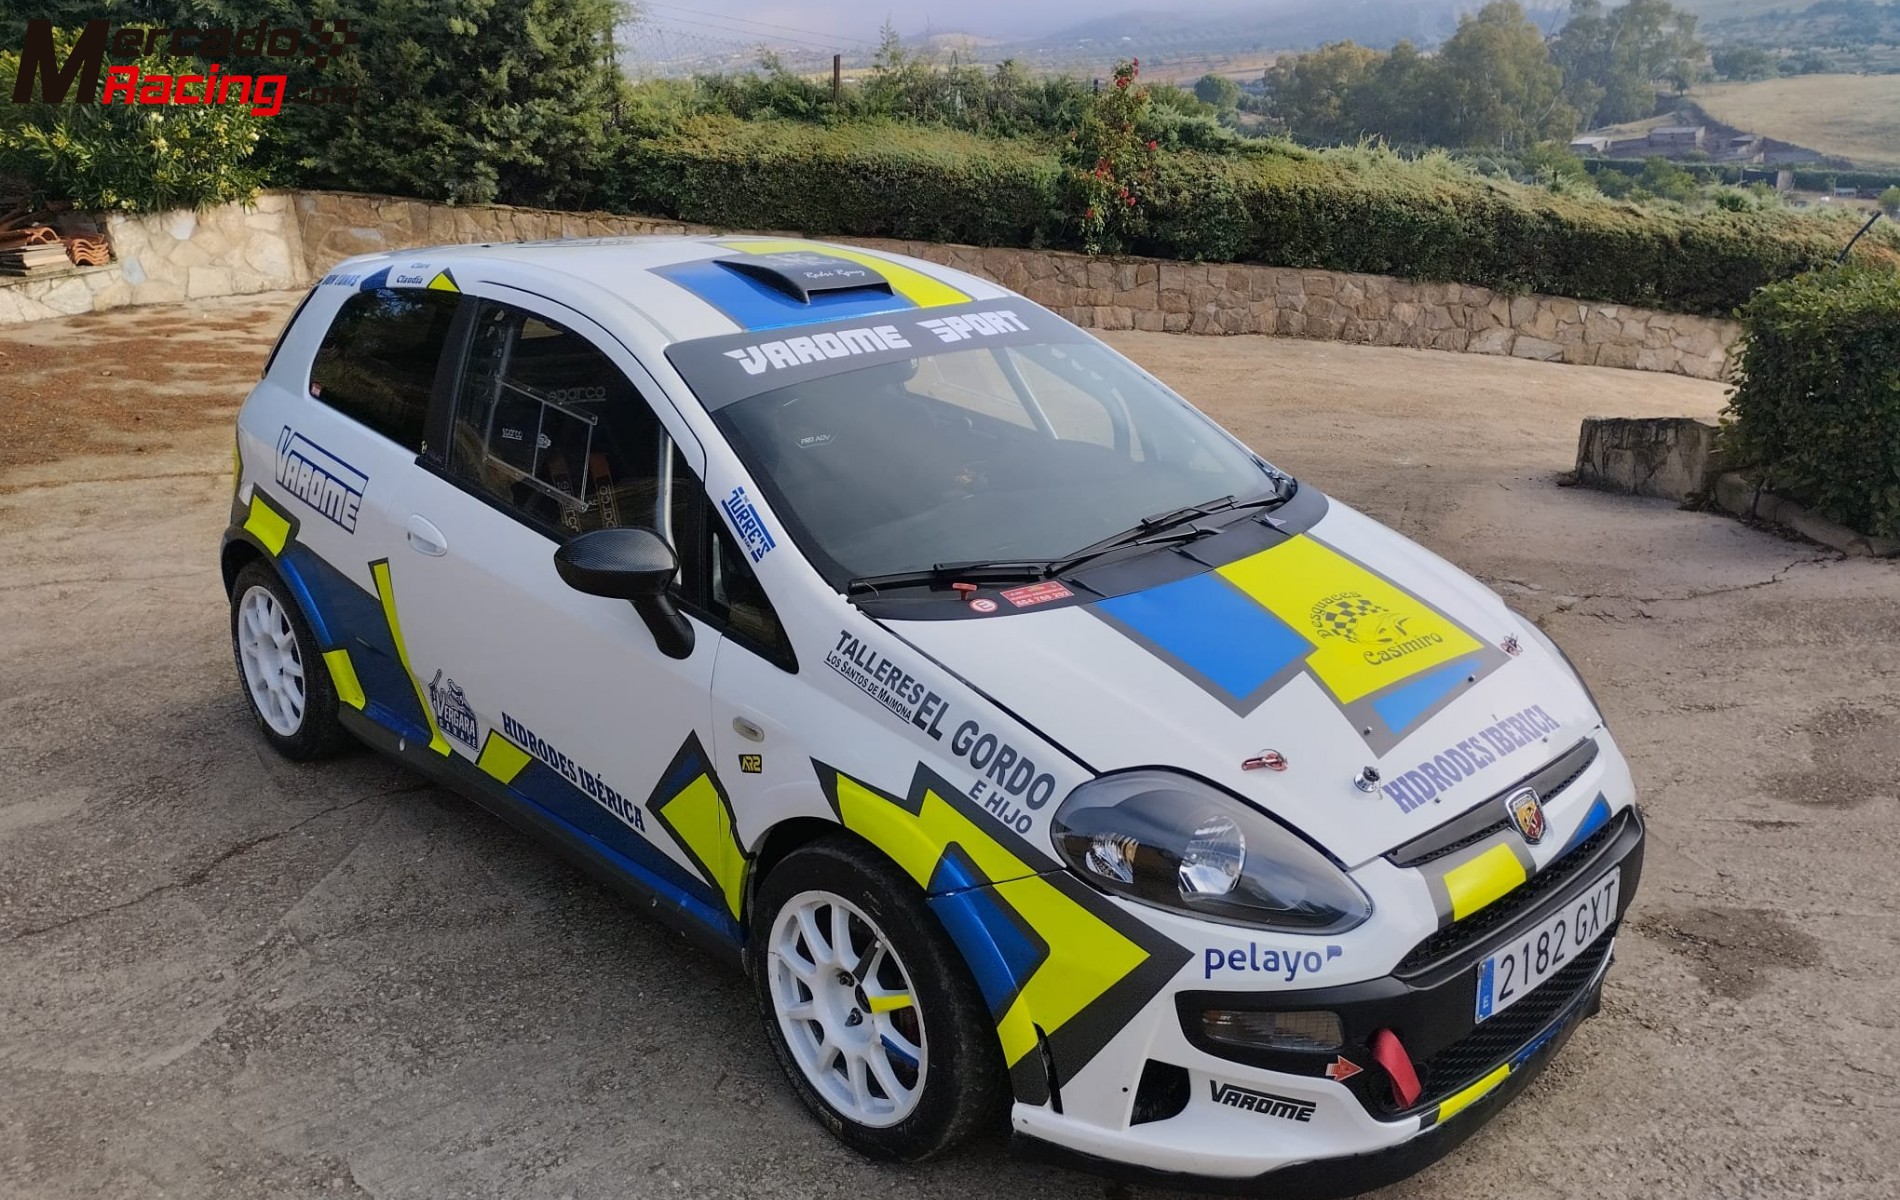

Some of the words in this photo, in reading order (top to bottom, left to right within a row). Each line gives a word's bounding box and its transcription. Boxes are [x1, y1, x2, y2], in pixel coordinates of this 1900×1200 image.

[723, 325, 912, 375] VAROME
[916, 310, 1030, 343] SPORT
[276, 424, 369, 535] VAROME
[1310, 591, 1362, 639] Desguaces
[1363, 632, 1444, 666] Casimiro
[435, 689, 476, 738] VERGARA
[836, 629, 925, 705] TALLERES
[911, 691, 950, 741] EL
[952, 720, 1056, 811] GORDO
[502, 711, 578, 783] HIDRODES
[577, 766, 646, 834] IBÉRICA
[1381, 736, 1497, 814] HIDRODES
[1478, 703, 1561, 757] IBÉRICA
[968, 780, 988, 801] E
[984, 795, 1033, 835] HIJO
[1205, 942, 1323, 982] pelayo
[1499, 919, 1567, 1002] 2182
[1575, 879, 1616, 946] GXT
[1210, 1079, 1317, 1123] VAROME
